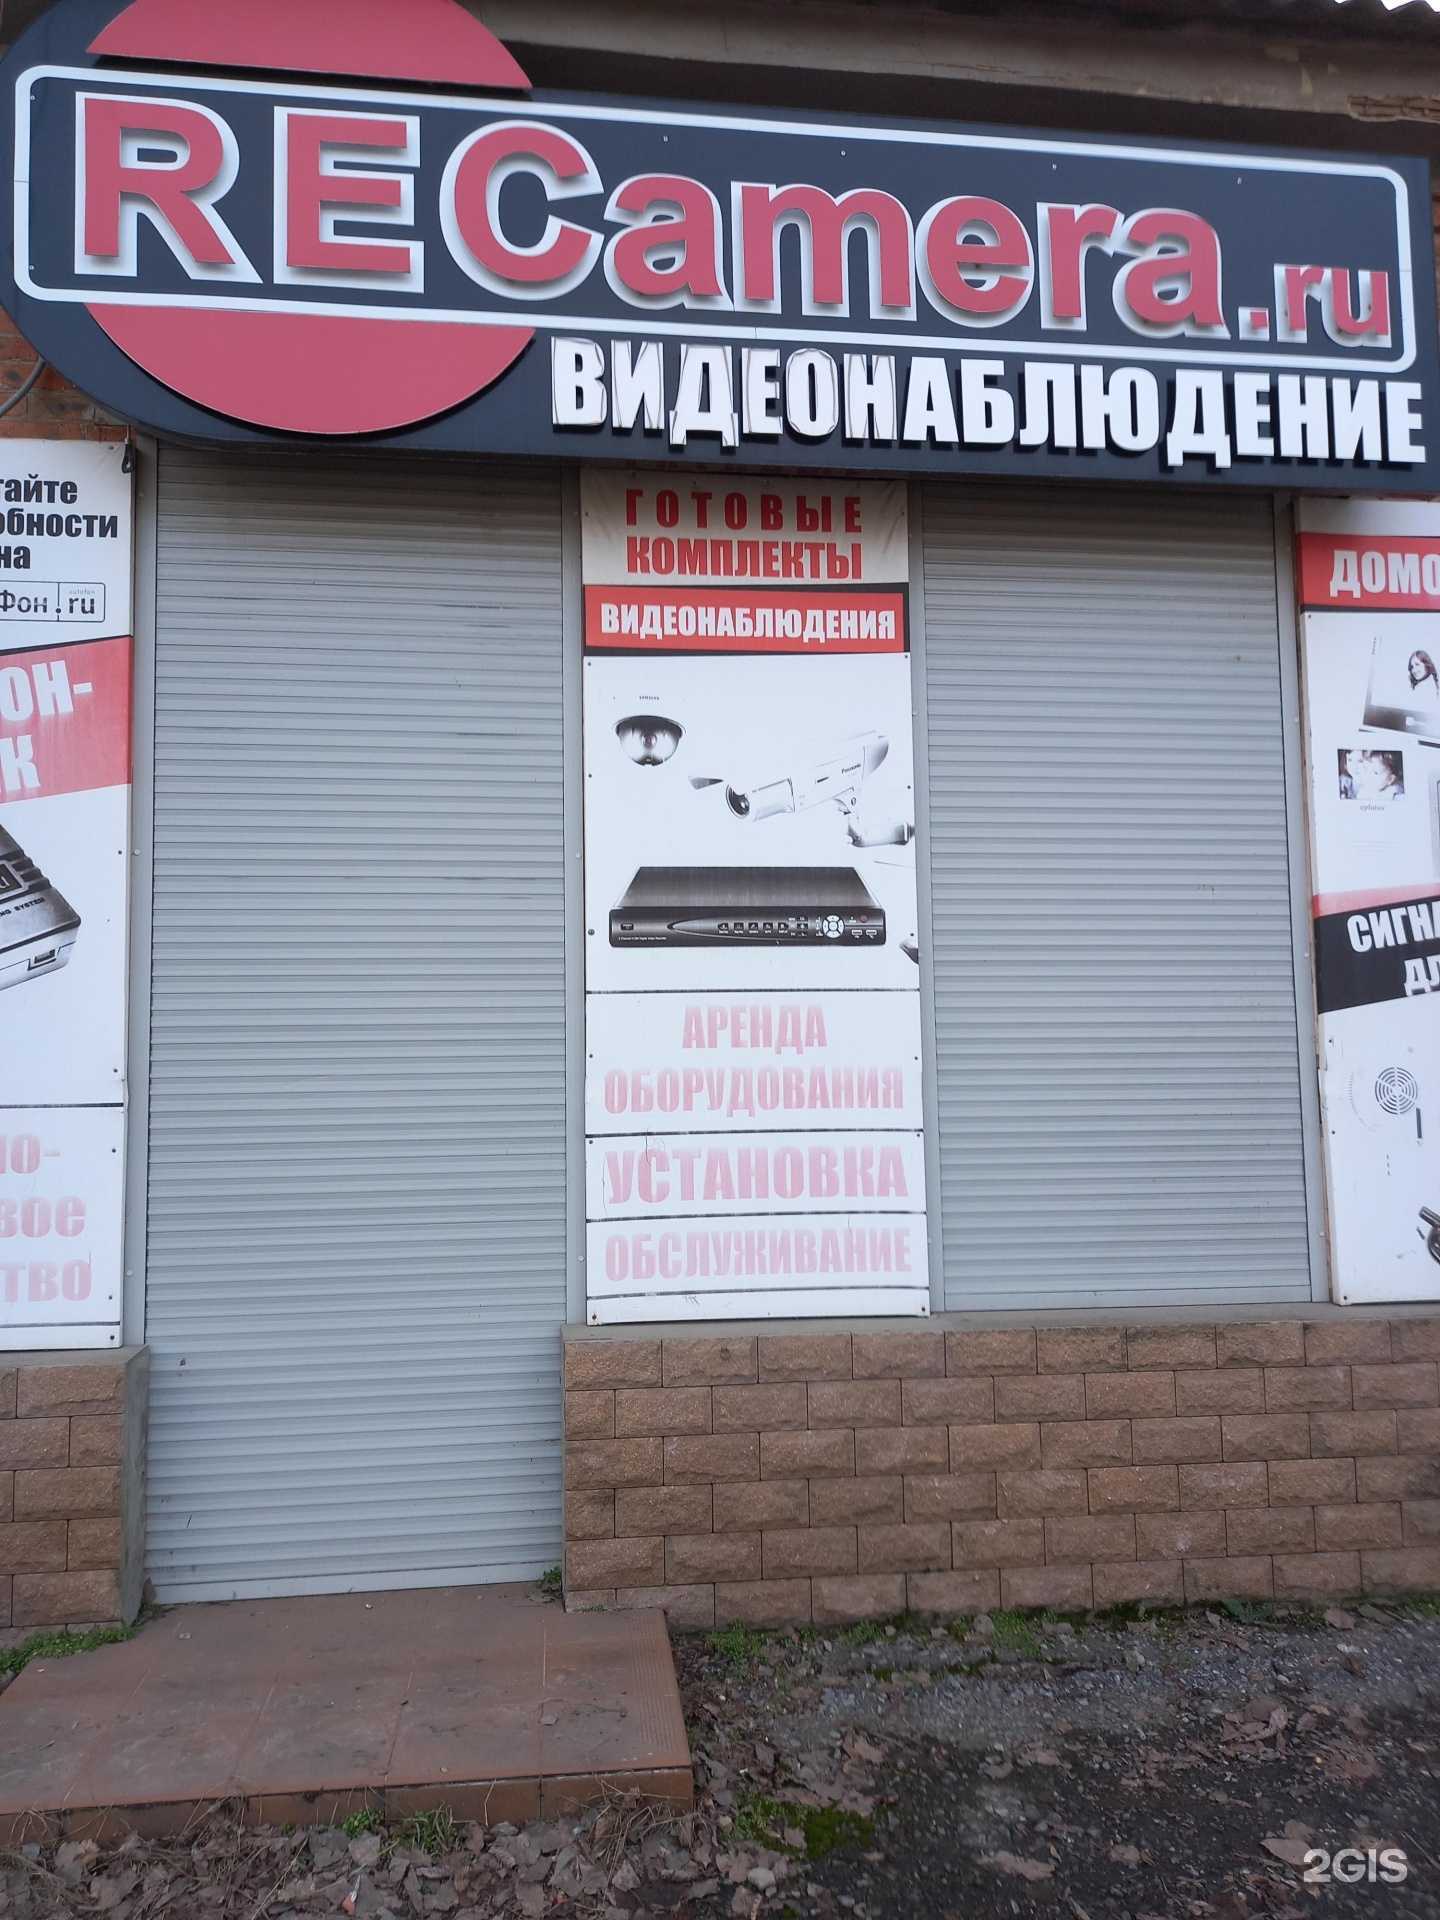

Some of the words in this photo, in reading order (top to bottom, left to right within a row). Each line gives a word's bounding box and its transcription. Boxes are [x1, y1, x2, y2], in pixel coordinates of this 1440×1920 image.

[75, 91, 1393, 348] RECamera.ru
[551, 337, 1427, 469] ВИДЕОНАБЛЮДЕНИЕ
[0, 473, 78, 504] айте
[625, 487, 863, 533] ГОТОВЫЕ
[626, 535, 863, 580] КОМПЛЕКТЫ
[600, 602, 896, 643] ВИДЕОНАБЛЮДЕНИЯ
[0, 734, 41, 793] К
[682, 1005, 828, 1055] АРЕНДА
[604, 1067, 904, 1117] ОБОРУДОВАНИЯ
[607, 1146, 909, 1204] УСТАНОВКА
[605, 1228, 913, 1281] ОБСЛУЖИВАНИЕ
